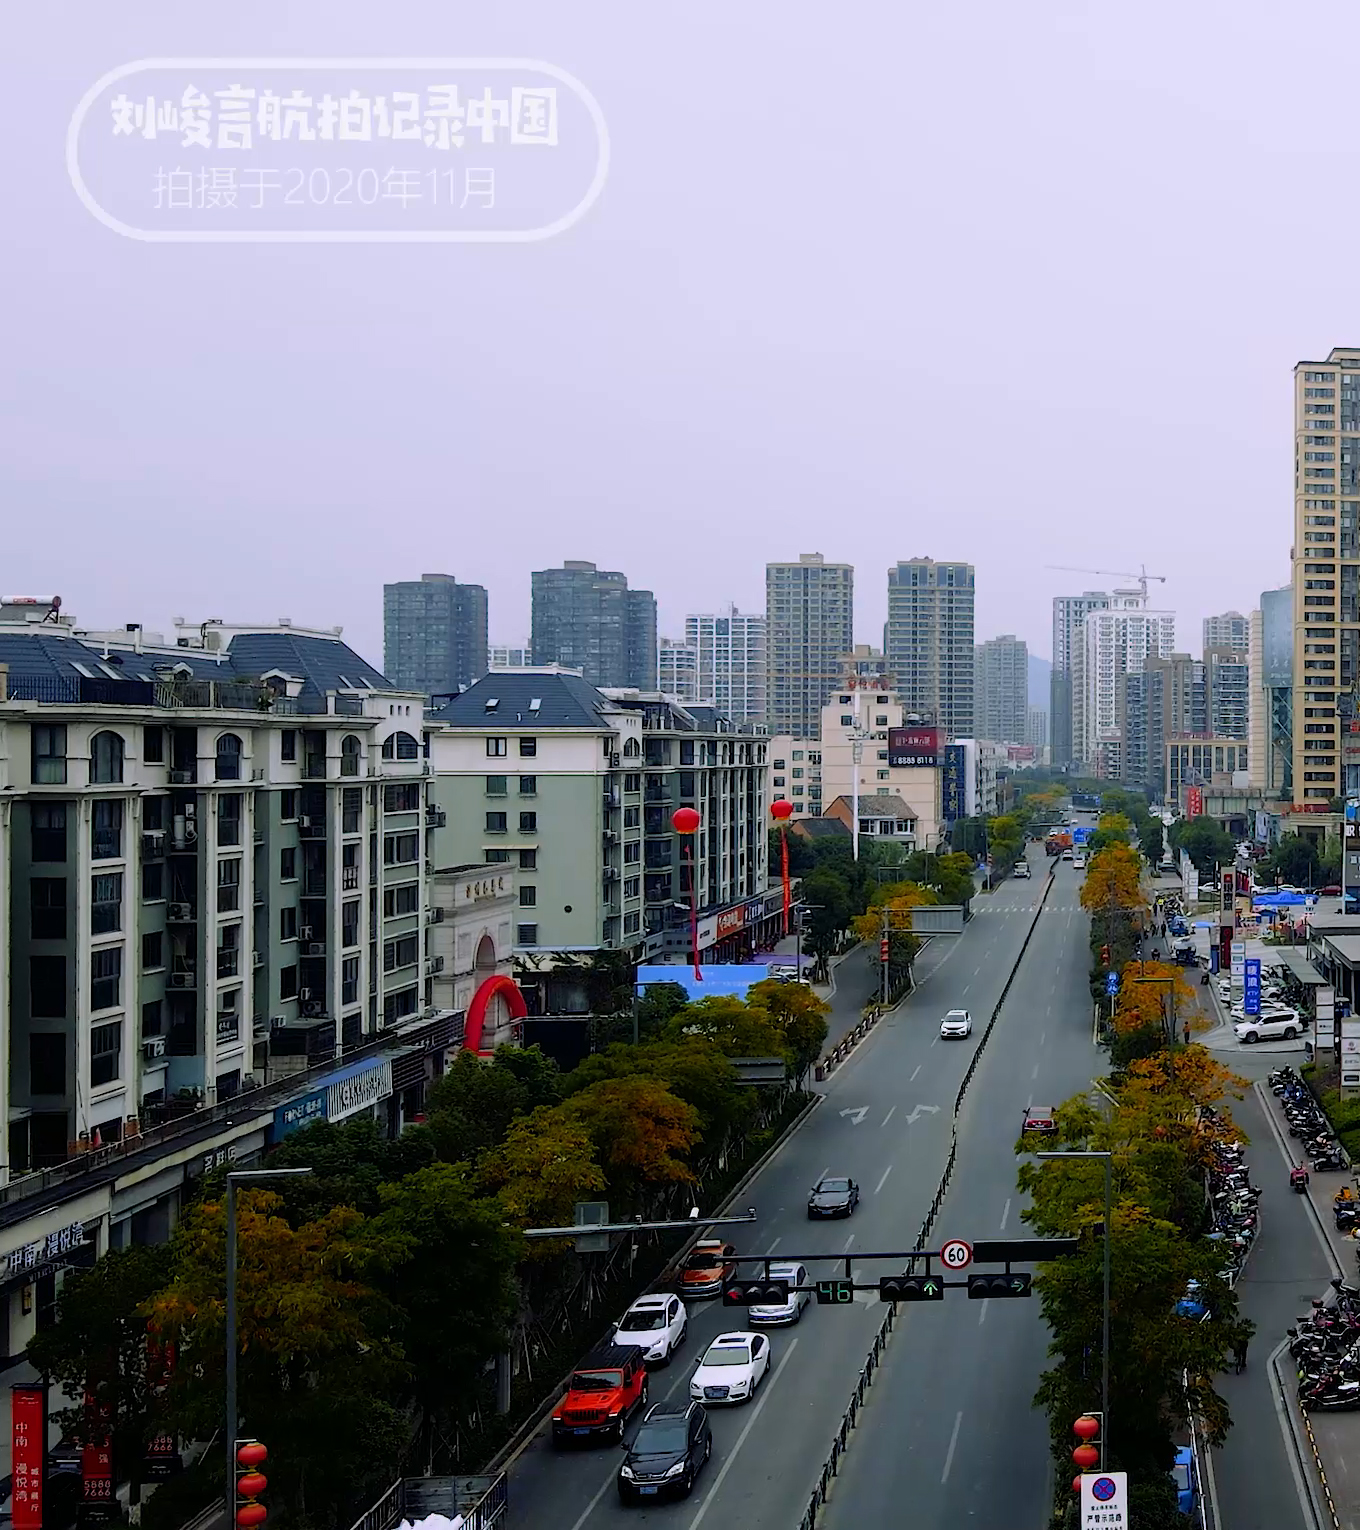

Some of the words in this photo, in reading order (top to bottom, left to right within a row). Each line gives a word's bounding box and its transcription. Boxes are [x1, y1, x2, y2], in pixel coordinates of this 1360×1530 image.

[948, 1247, 965, 1263] 60
[820, 1280, 850, 1302] 46
[16, 1422, 28, 1502] 中南·漫悦湾
[84, 1480, 111, 1489] 5888
[84, 1488, 111, 1497] 7666
